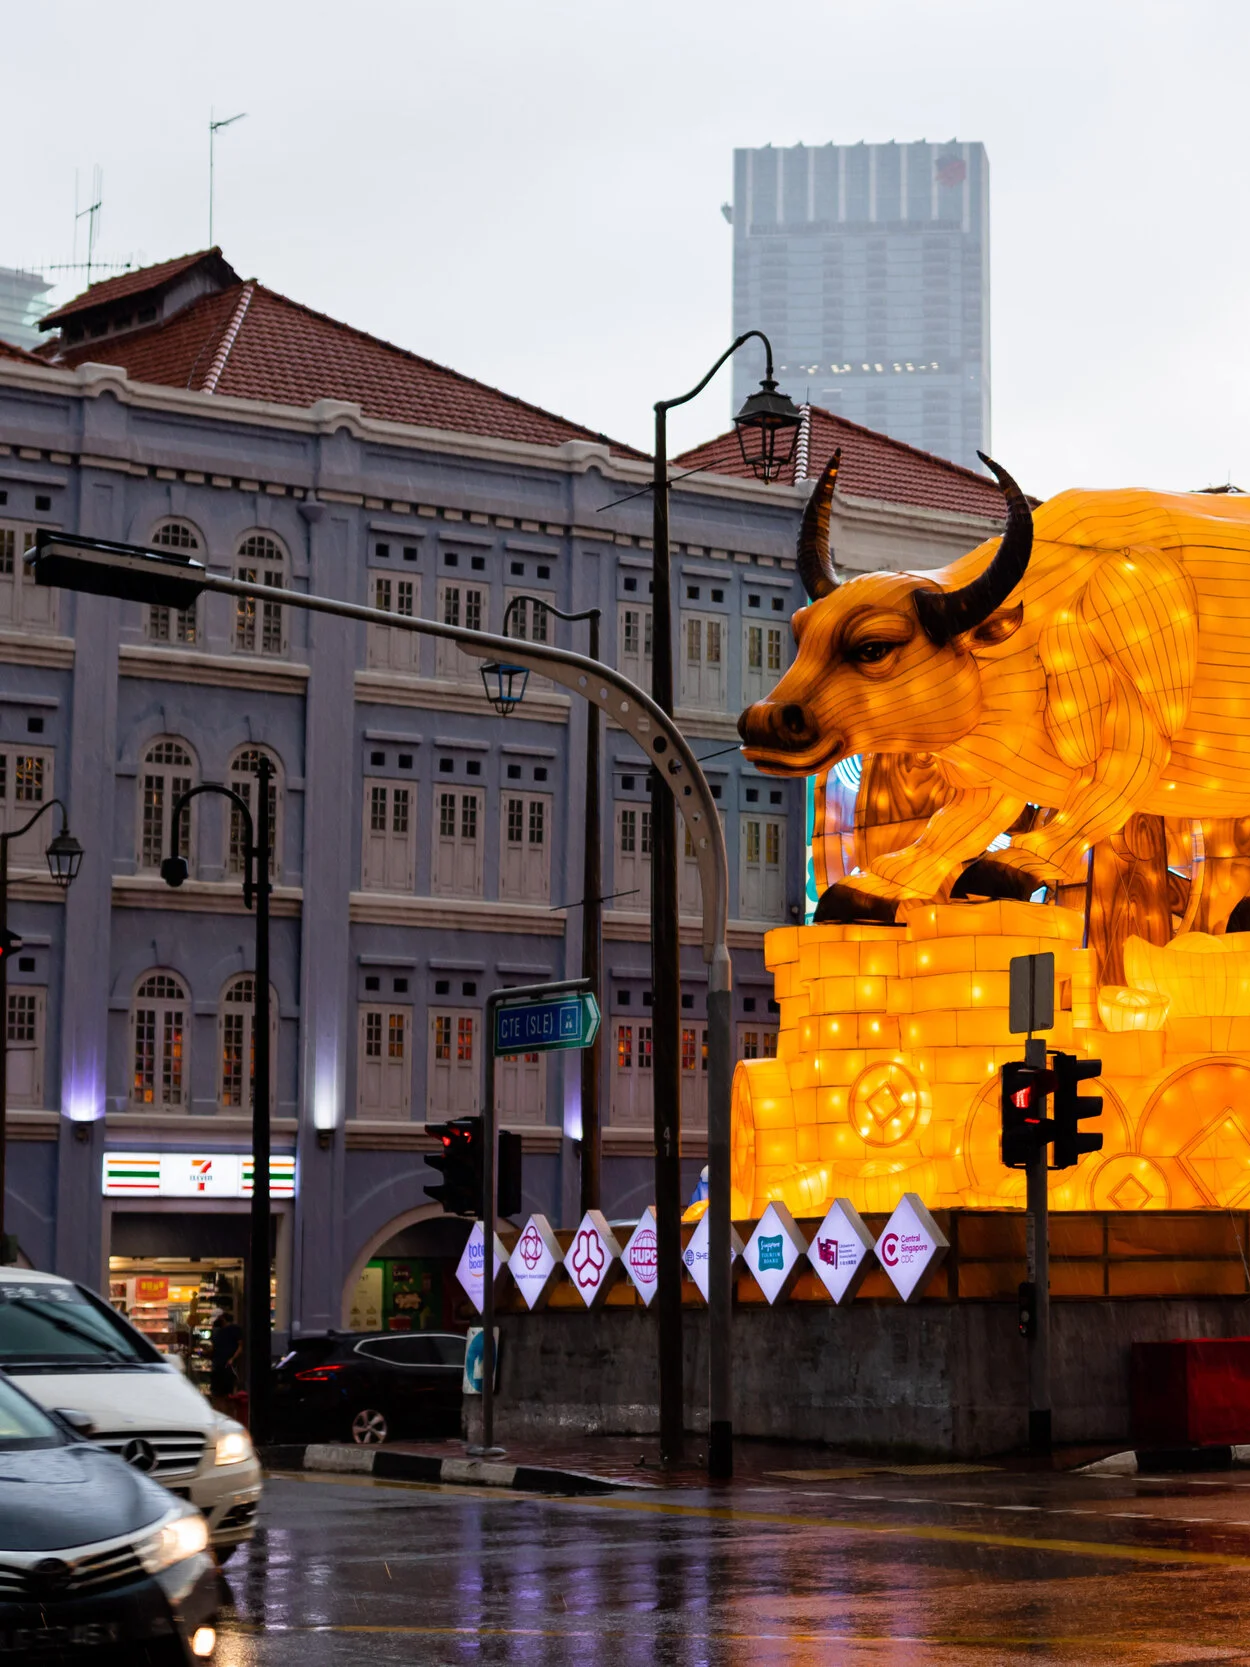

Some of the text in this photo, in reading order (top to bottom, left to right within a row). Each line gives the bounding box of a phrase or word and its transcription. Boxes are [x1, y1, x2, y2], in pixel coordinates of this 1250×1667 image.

[501, 1011, 553, 1039] CTE (SLE)
[900, 1234, 921, 1243] Central
[900, 1244, 928, 1253] Singapore
[900, 1254, 914, 1264] CDC
